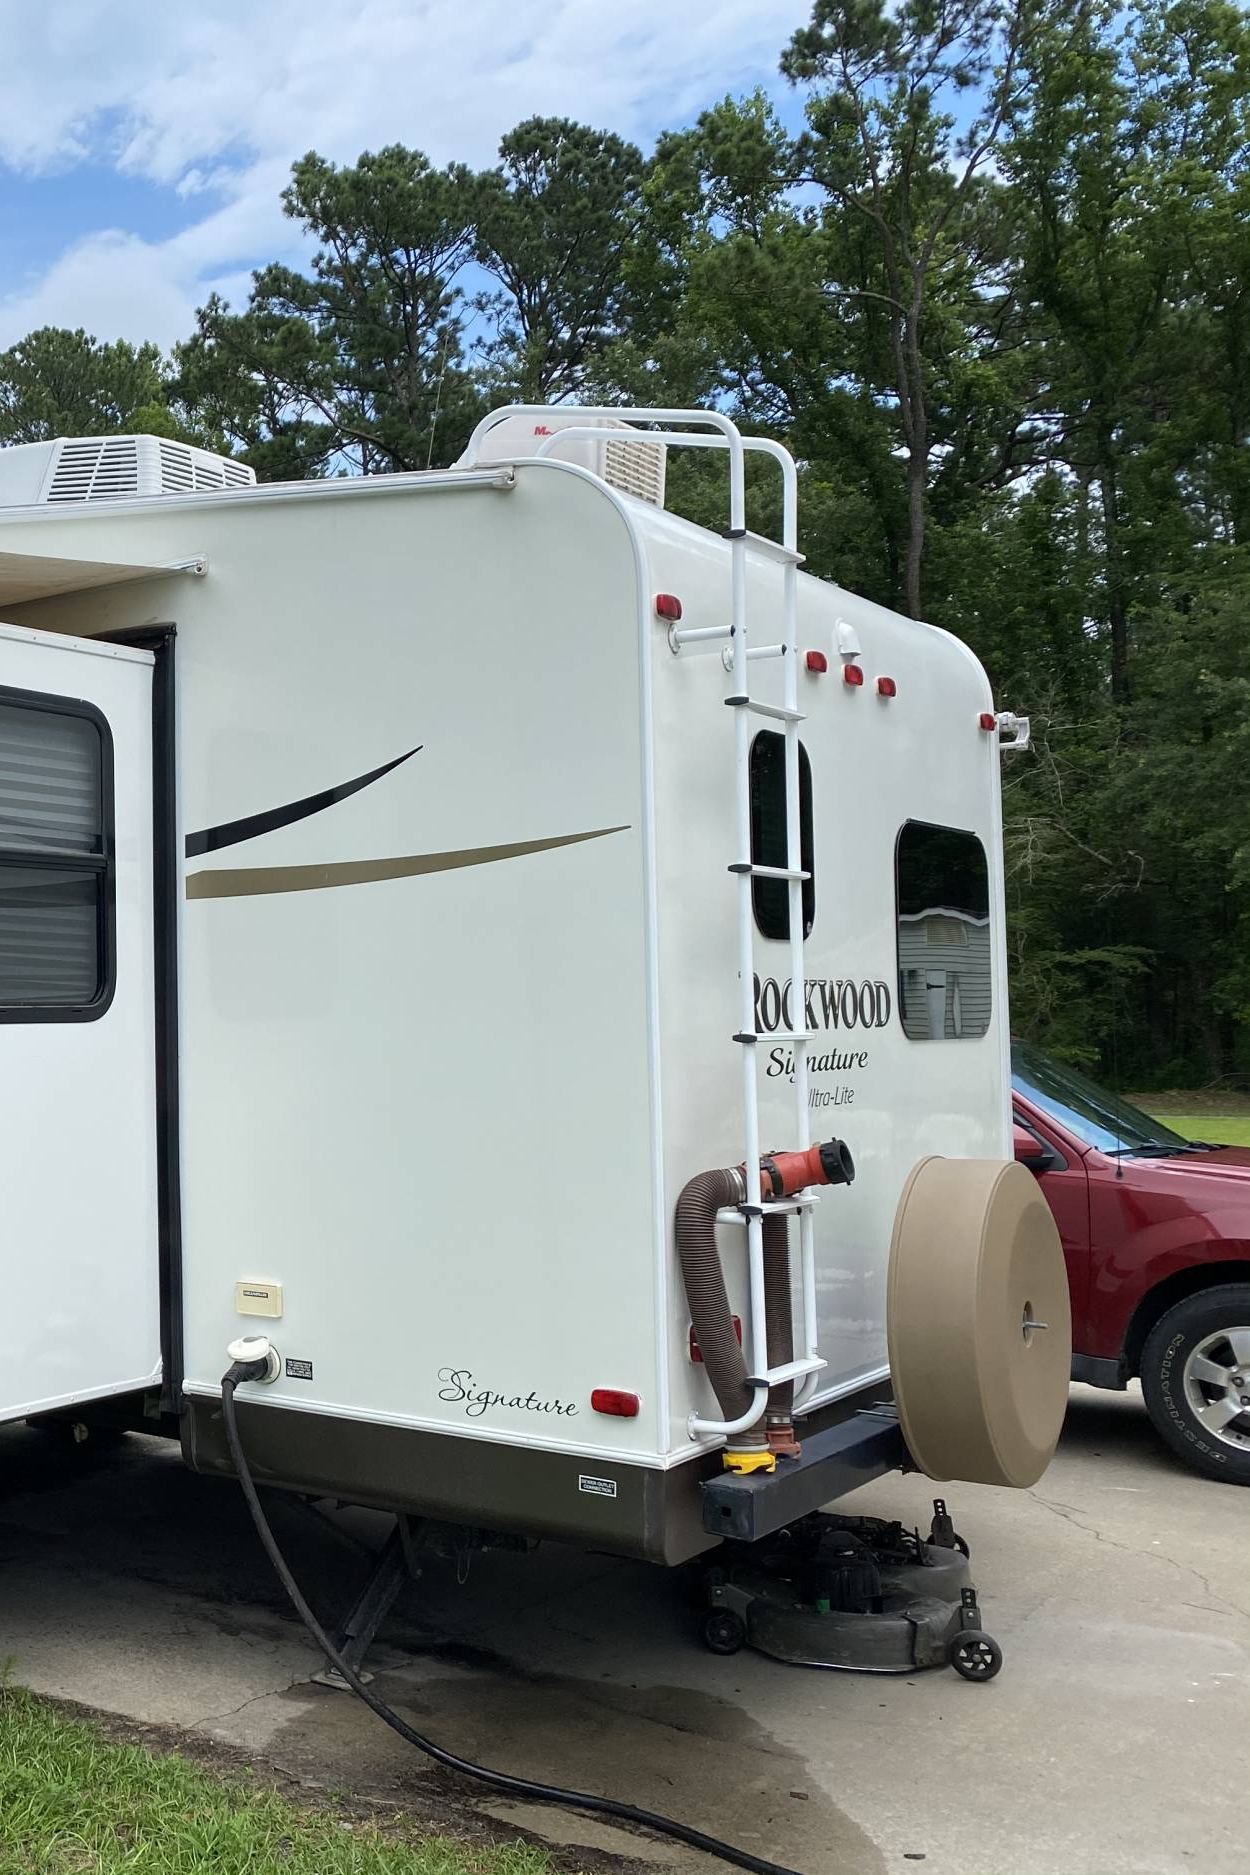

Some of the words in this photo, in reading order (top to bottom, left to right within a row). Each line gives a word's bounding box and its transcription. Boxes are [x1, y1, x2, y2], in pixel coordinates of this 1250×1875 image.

[806, 1086, 855, 1108] ltra-Lite
[437, 1367, 580, 1417] Signature
[1160, 1333, 1228, 1463] DESTINATION
